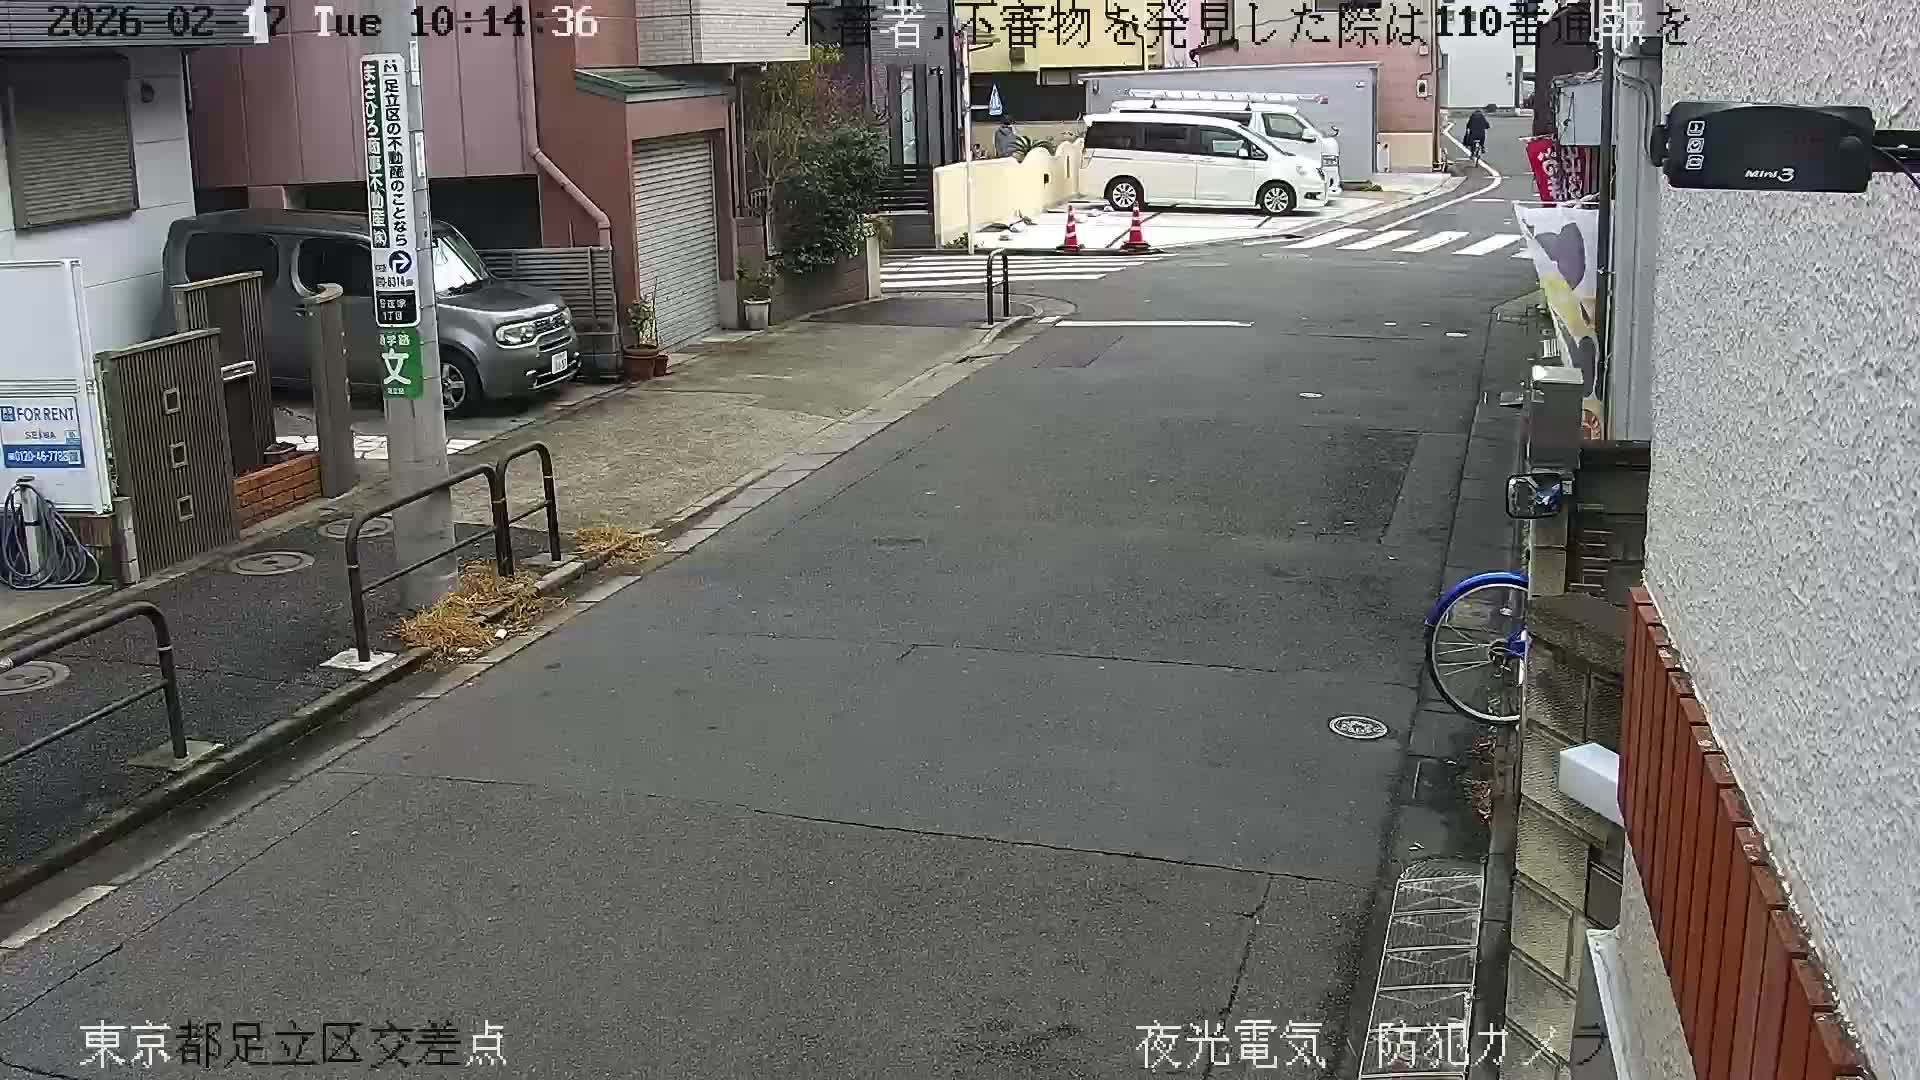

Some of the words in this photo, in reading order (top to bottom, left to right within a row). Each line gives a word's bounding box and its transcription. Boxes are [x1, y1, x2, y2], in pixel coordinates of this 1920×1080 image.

[384, 79, 408, 246] 足立区の不動産のことなら
[381, 347, 412, 384] 文
[17, 408, 40, 421] FOR
[43, 408, 74, 421] RENT
